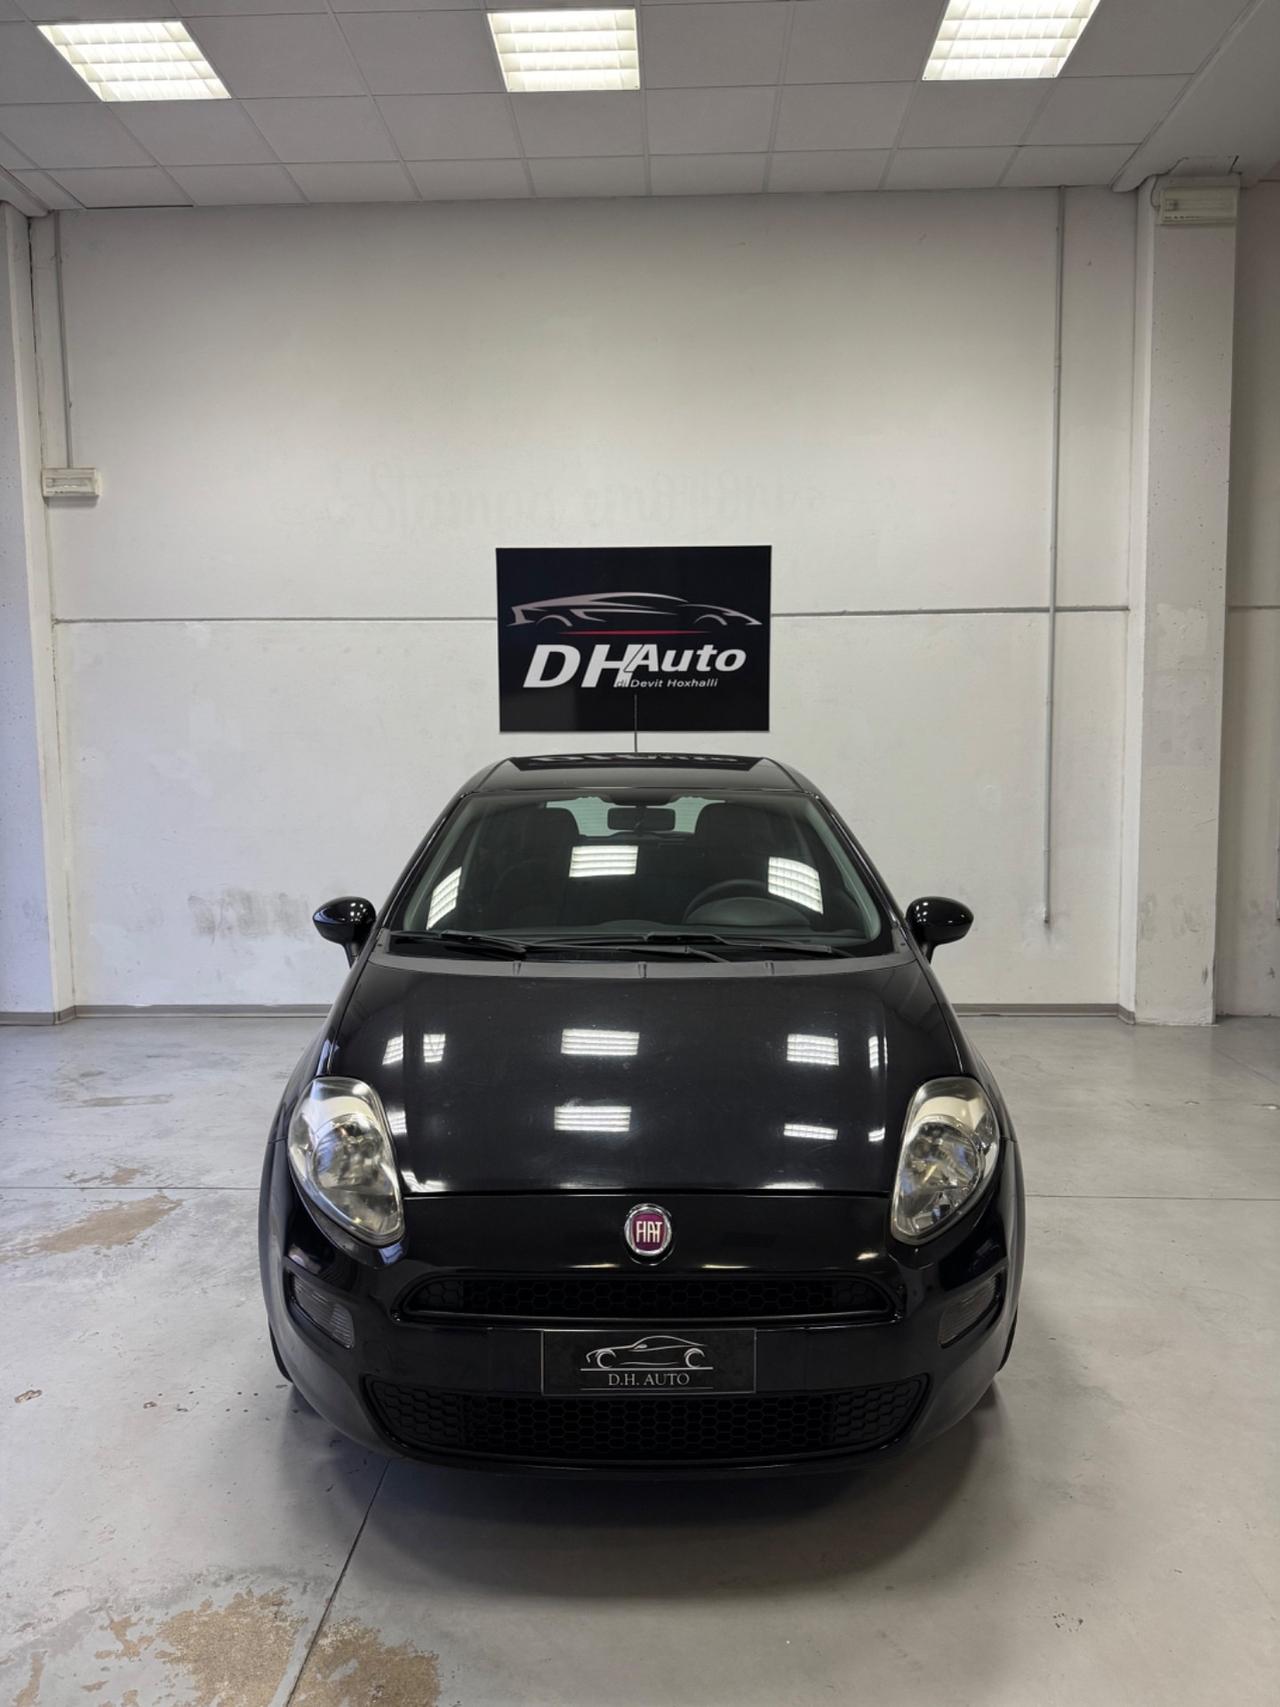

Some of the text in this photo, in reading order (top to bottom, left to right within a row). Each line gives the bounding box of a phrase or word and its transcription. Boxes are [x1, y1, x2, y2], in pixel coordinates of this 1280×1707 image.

[625, 644, 746, 672] Auto
[630, 679, 663, 688] Devit
[667, 678, 718, 688] Hoxhalli
[635, 1220, 663, 1243] FIAT
[608, 1373, 690, 1386] D.H. AUTO
